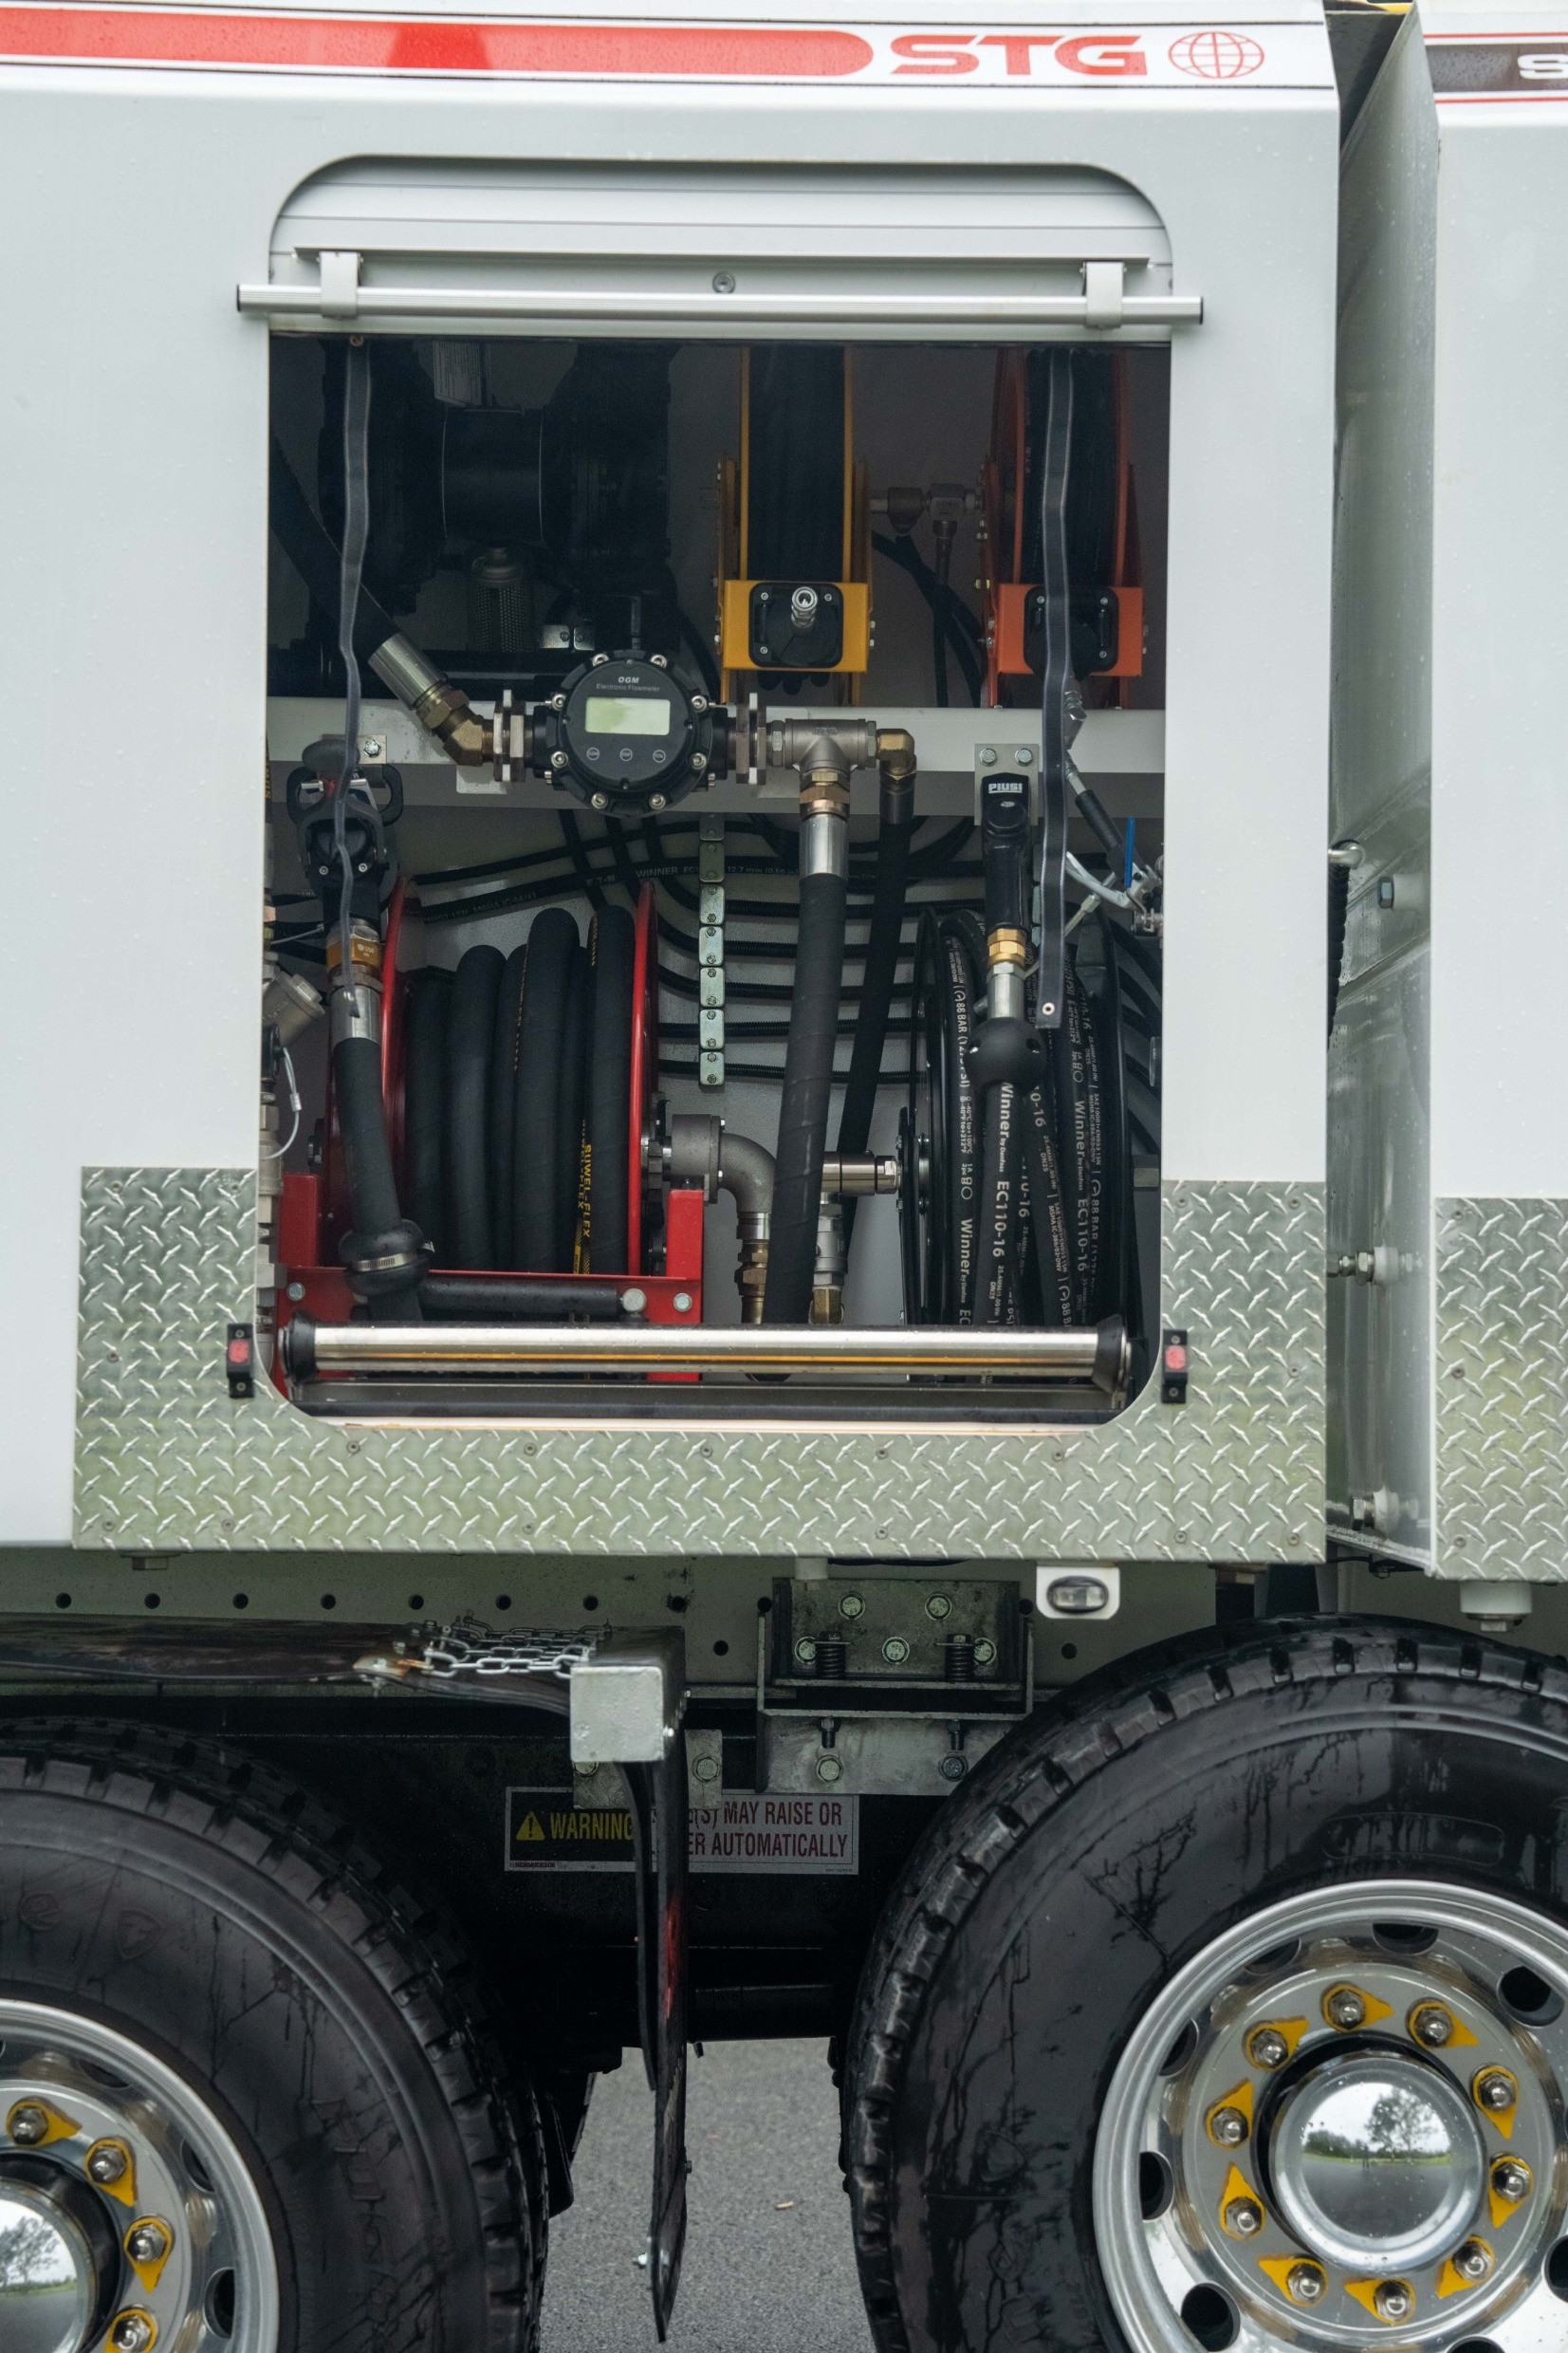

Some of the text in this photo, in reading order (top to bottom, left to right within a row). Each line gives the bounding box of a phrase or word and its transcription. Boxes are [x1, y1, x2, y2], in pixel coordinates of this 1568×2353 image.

[889, 34, 1147, 77] STG
[987, 783, 1023, 794] PIUSI
[636, 866, 678, 879] WINNER
[956, 1003, 966, 1013] 88
[957, 1014, 968, 1032] BAR
[1000, 1082, 1014, 1138] Winner
[1075, 1101, 1086, 1158] Winner
[1040, 1153, 1048, 1172] DN25
[1078, 1158, 1083, 1166] by
[582, 1144, 592, 1238] SUWEL-FLEX
[1091, 1199, 1098, 1214] 88
[992, 1180, 1009, 1257] EC110-16
[1077, 1198, 1089, 1271] EC110-16
[960, 1219, 972, 1274] Winner
[960, 1283, 968, 1303] Danfoss
[1061, 1303, 1070, 1315] 88
[549, 1811, 634, 1841] WARNING
[724, 1801, 762, 1825] MAY
[765, 1801, 813, 1826] RAISE
[819, 1801, 842, 1826] OR
[710, 1832, 848, 1859] AUTOMATICALLY
